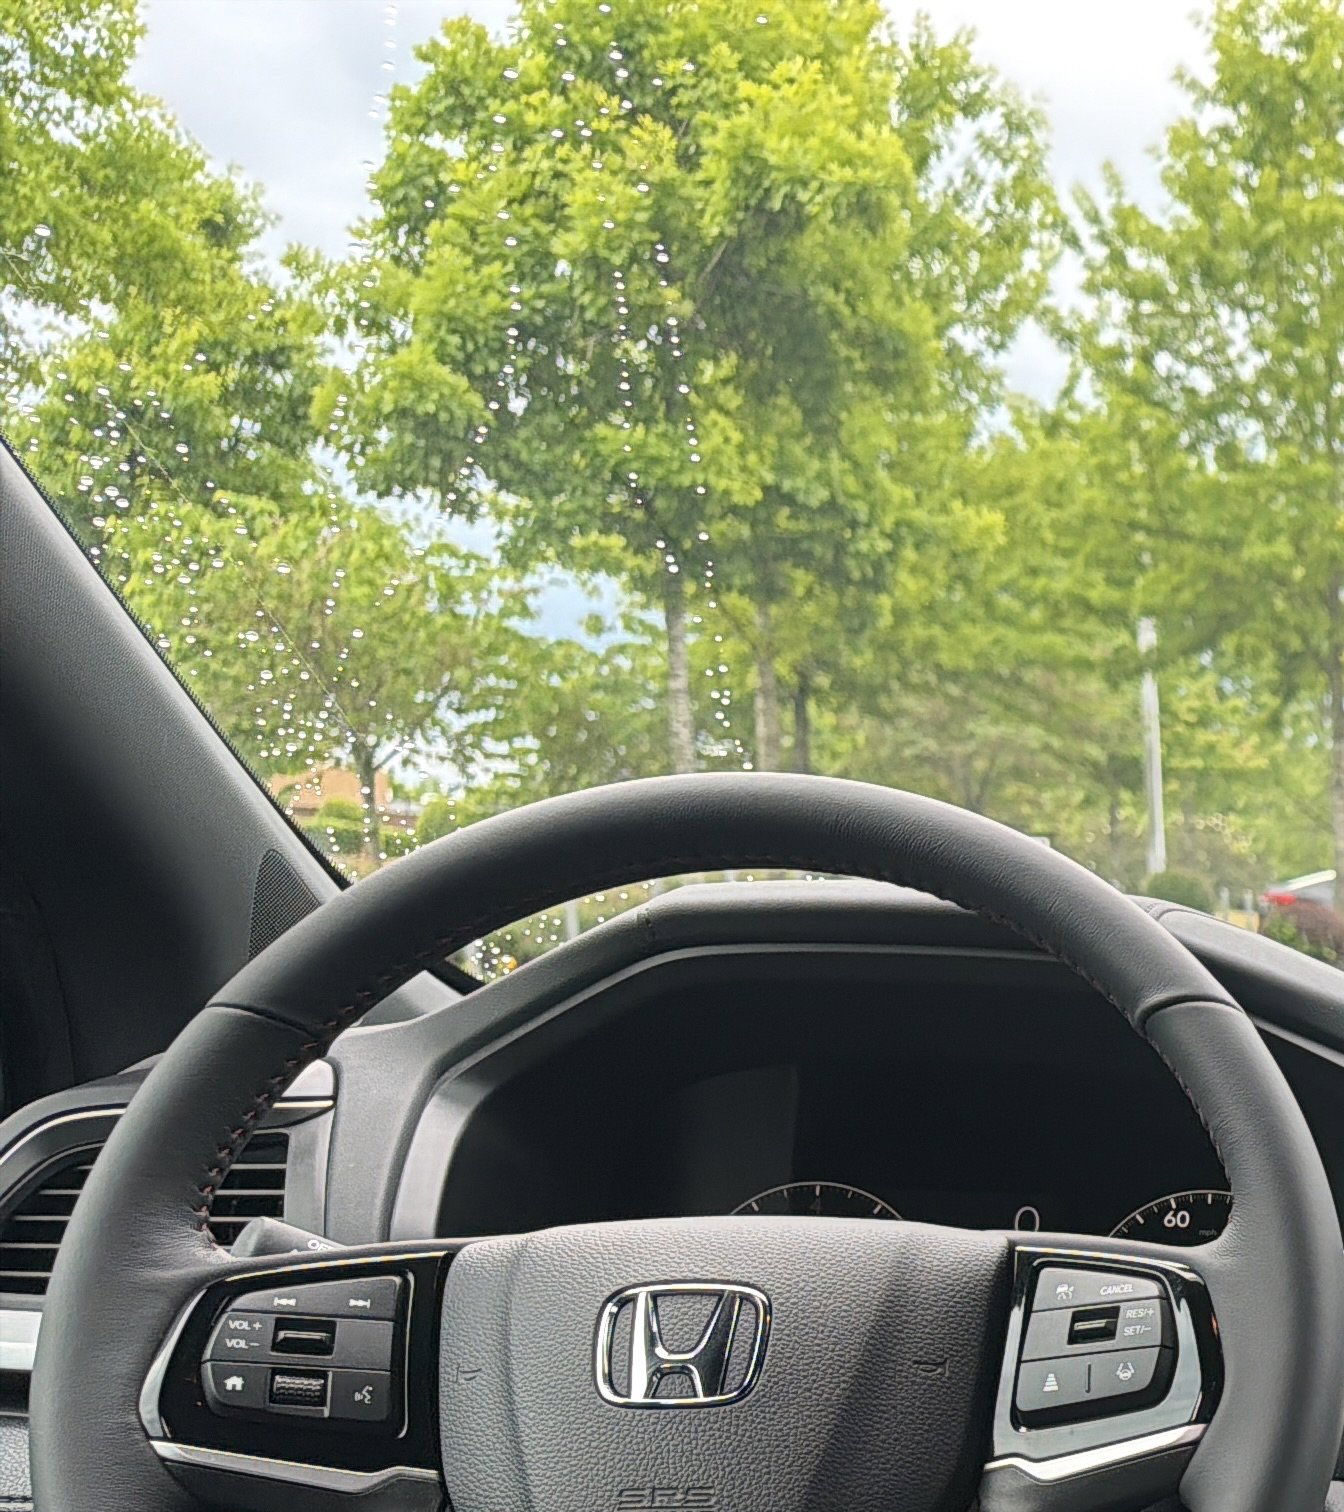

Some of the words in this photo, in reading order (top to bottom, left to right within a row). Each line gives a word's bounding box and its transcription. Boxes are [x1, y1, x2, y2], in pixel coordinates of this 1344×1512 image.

[1163, 1210, 1190, 1228] 60
[1198, 1229, 1217, 1237] mph
[1099, 1283, 1134, 1296] CANCEL
[618, 1485, 716, 1508] SRS
